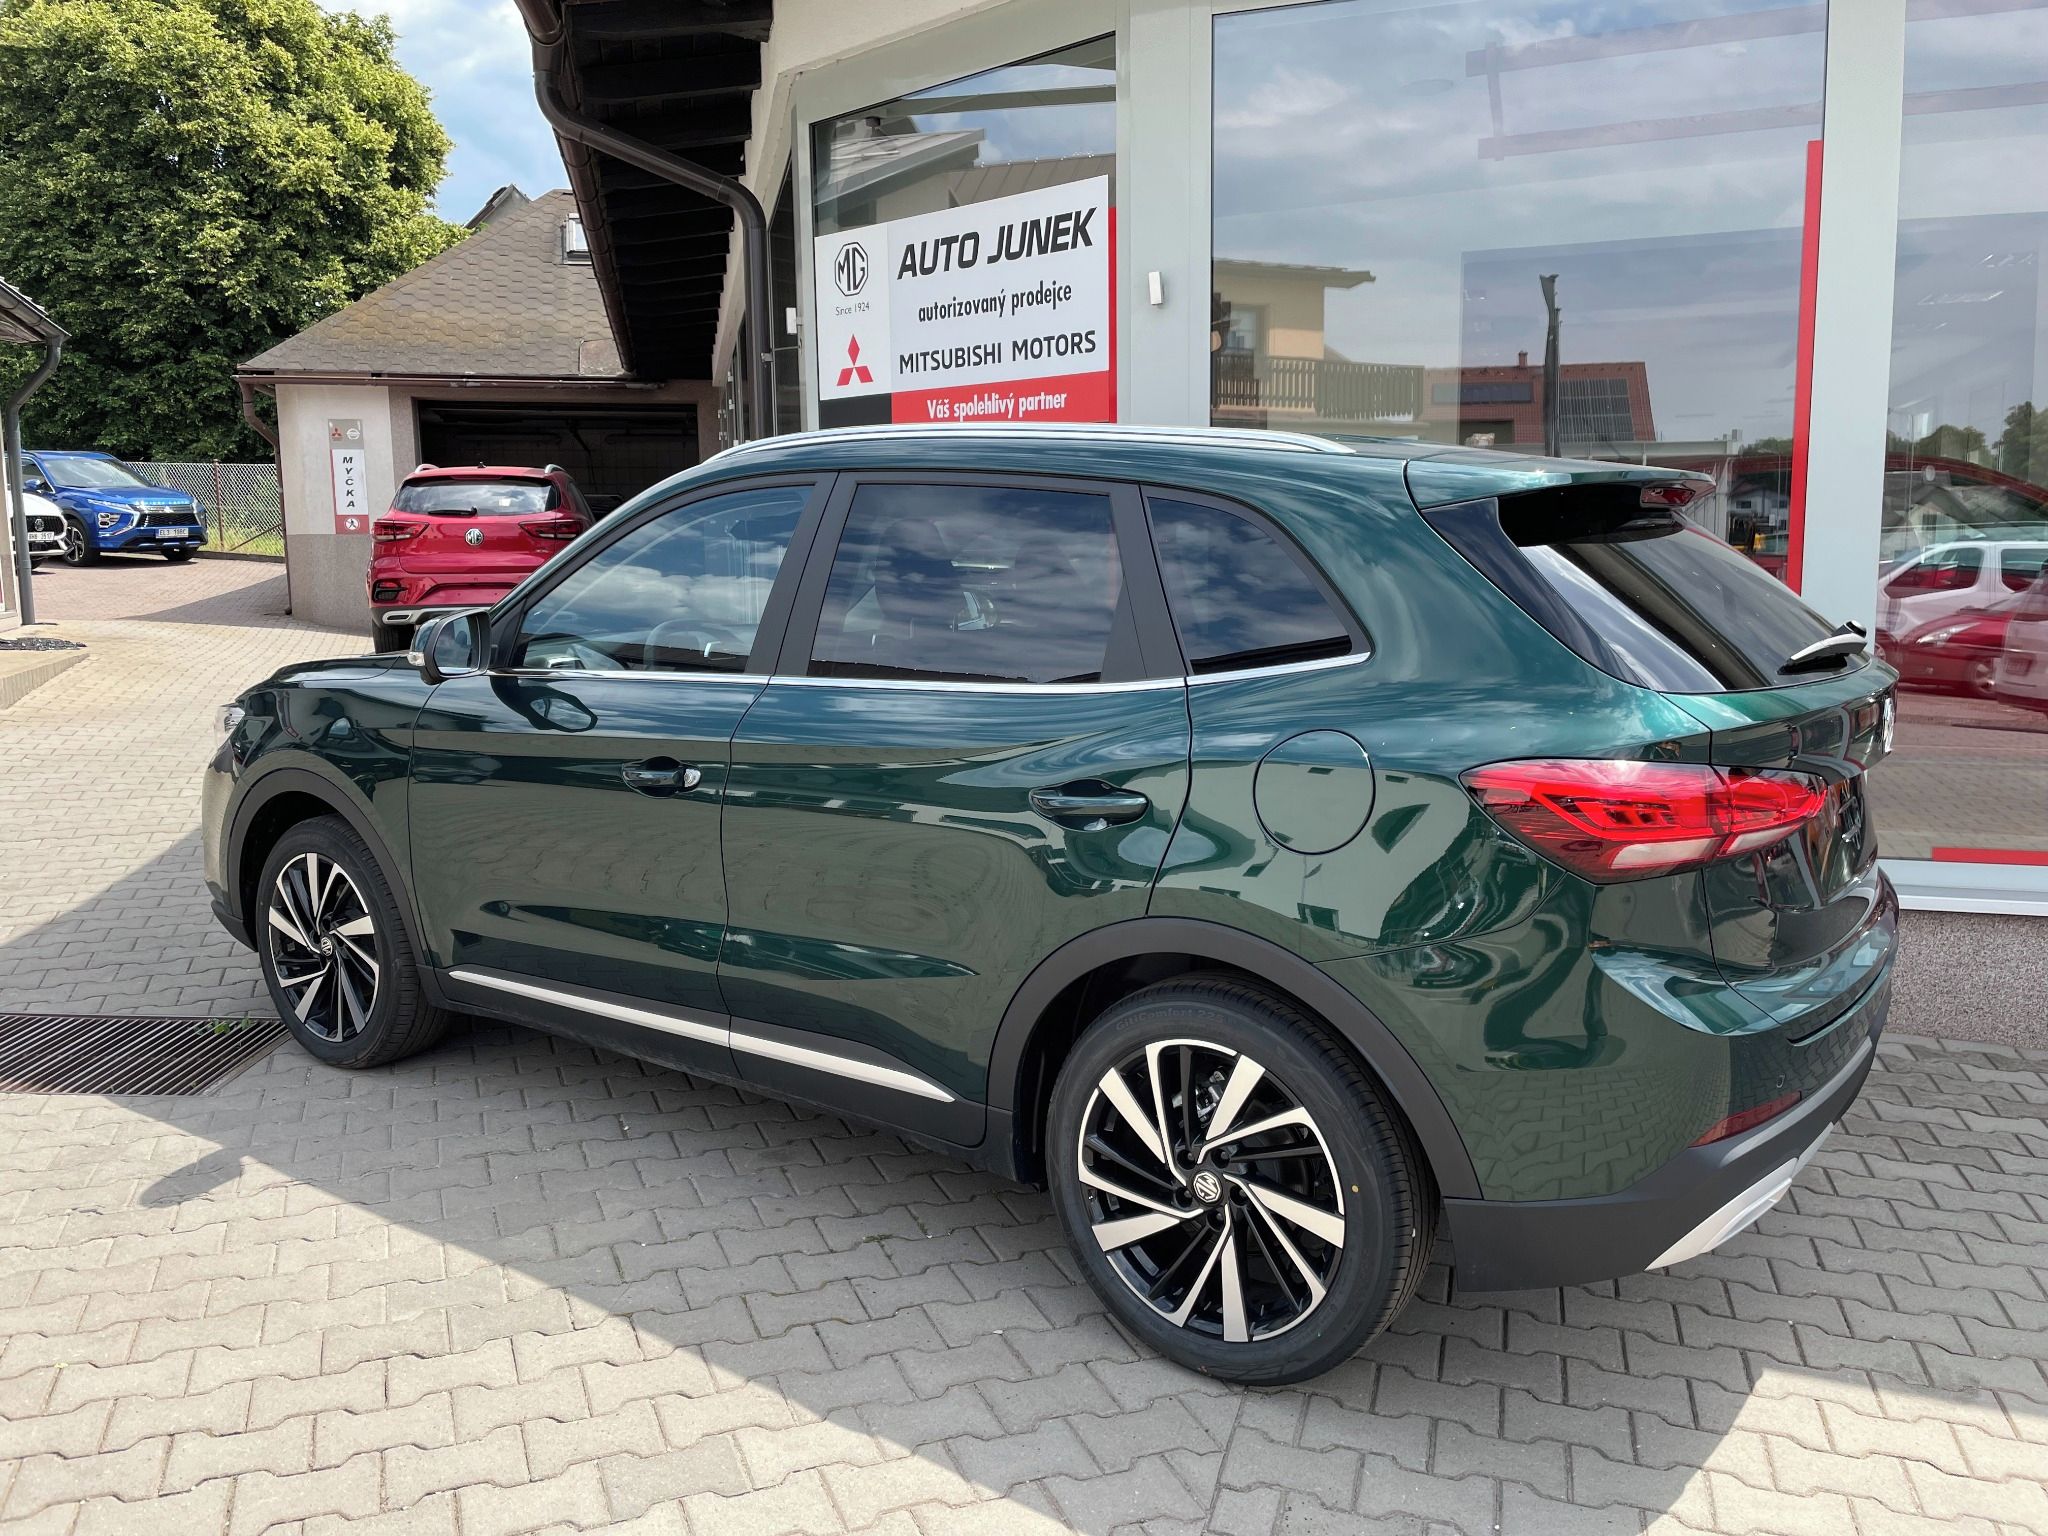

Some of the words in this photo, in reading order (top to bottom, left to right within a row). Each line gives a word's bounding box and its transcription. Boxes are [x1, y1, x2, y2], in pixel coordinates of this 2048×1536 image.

[896, 231, 980, 280] AUTO
[987, 207, 1098, 264] JUNEK
[836, 244, 867, 294] MG
[855, 301, 871, 313] 1924
[918, 289, 1007, 322] autorizovaný
[1011, 280, 1072, 316] prodejce
[899, 342, 1002, 375] MITSUBISHI
[1012, 330, 1097, 362] MOTORS
[927, 398, 950, 419] Váš
[953, 393, 1015, 422] spolehlivý
[1018, 392, 1068, 414] partner
[1195, 1174, 1218, 1200] MG
